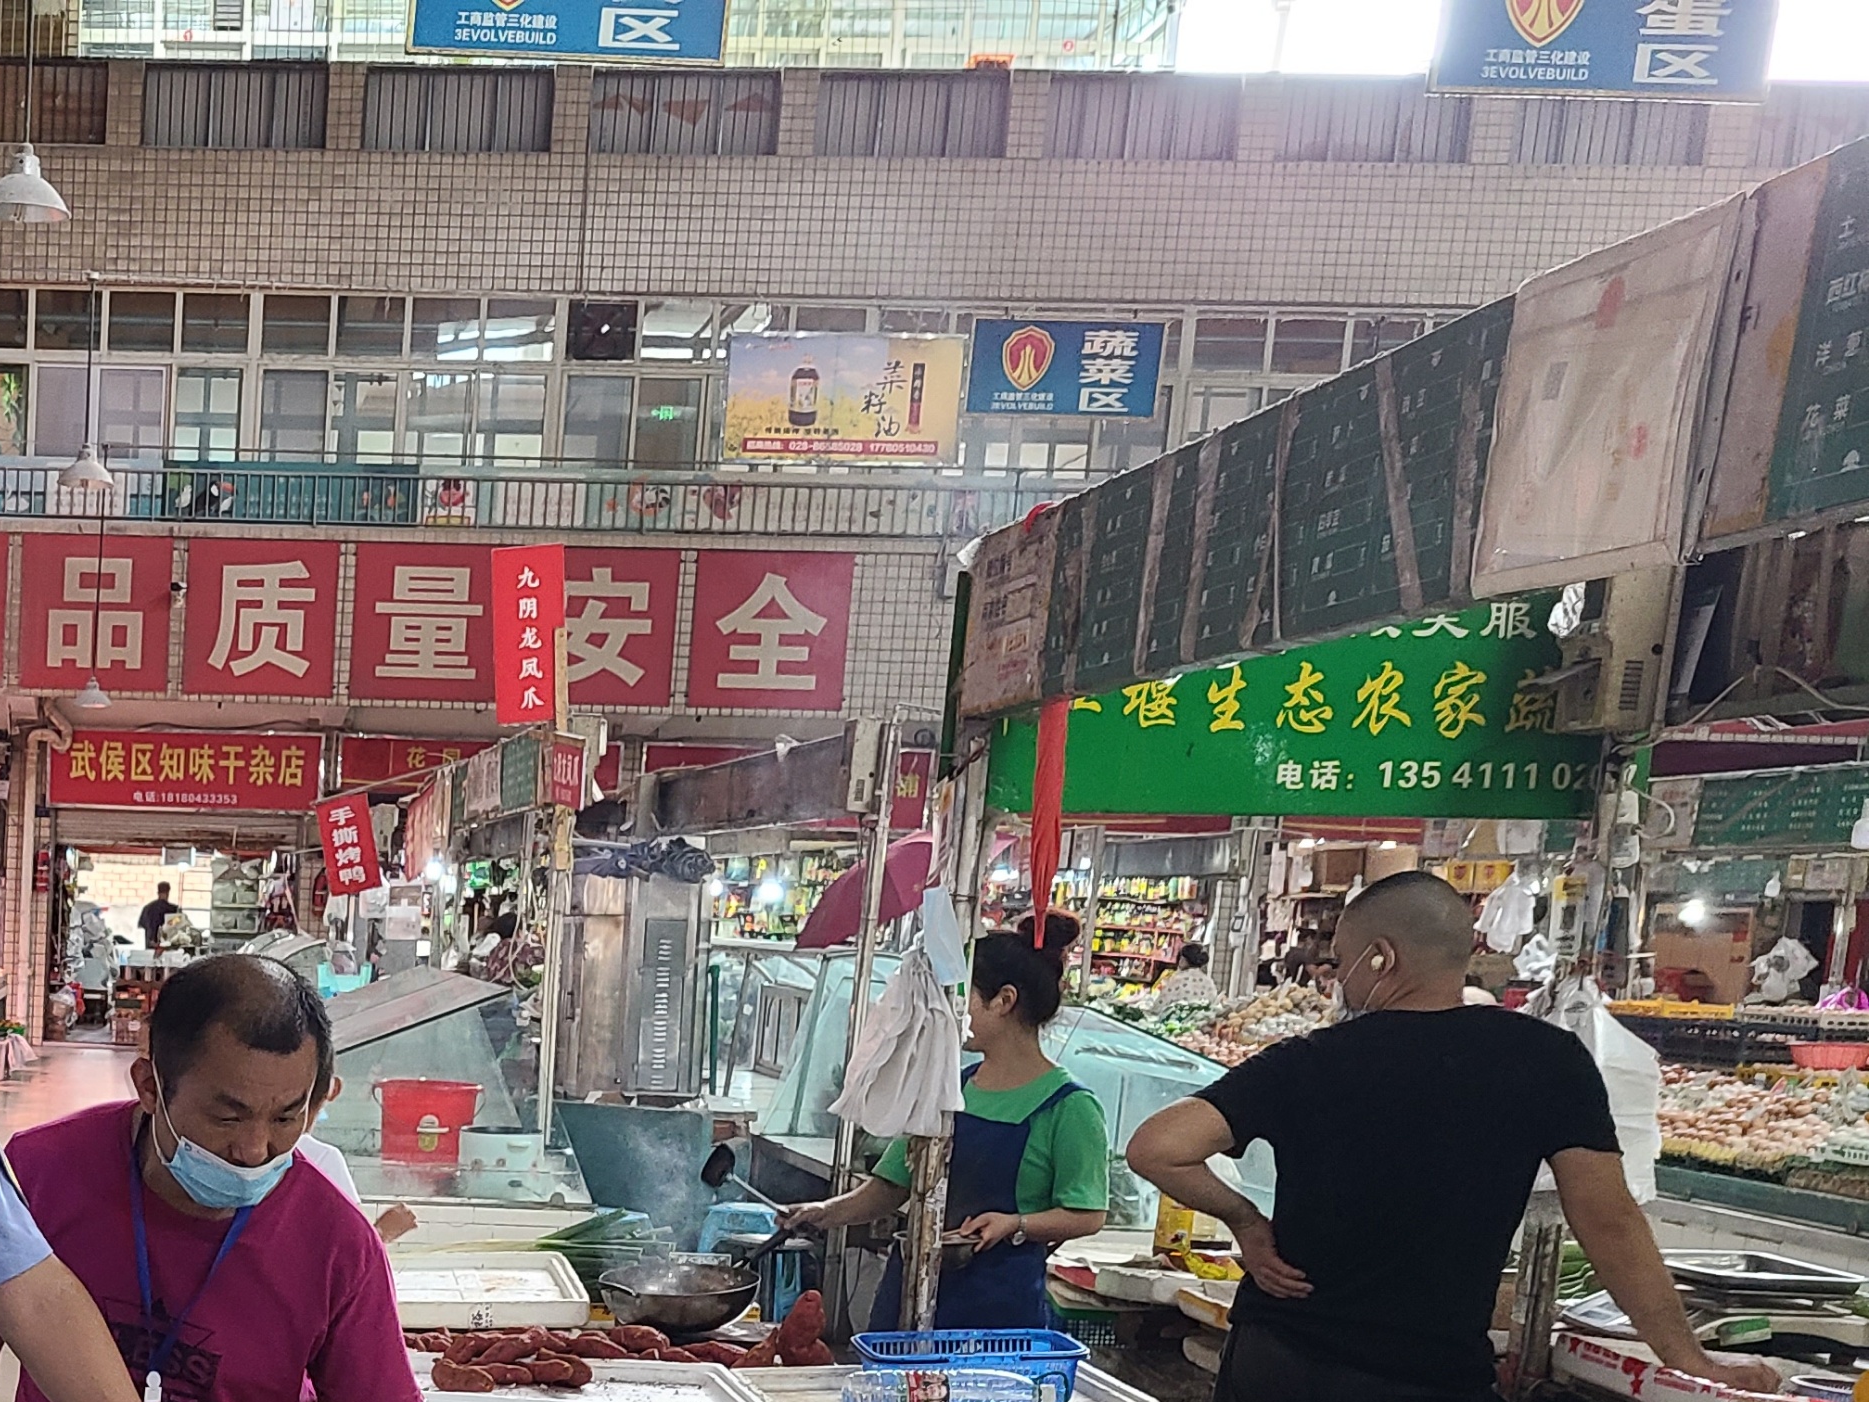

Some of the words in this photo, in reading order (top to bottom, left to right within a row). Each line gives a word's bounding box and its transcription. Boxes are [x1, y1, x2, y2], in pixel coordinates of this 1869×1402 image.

[454, 28, 556, 45] 3EVOLVEBUILD
[456, 11, 558, 30] 工商监管三化建设
[1480, 65, 1589, 82] 3EVOLVEBUILD
[1484, 49, 1591, 66] 工商监管三化建设
[1078, 330, 1140, 413] 蔬菜区
[515, 565, 545, 710] 九阴龙凤爪
[1071, 660, 1557, 740] 堰生态农家蔬
[69, 740, 306, 787] 武侯区知味干杂店
[1378, 760, 1442, 790] 135
[1451, 762, 1539, 790] 4111
[328, 805, 366, 886] 手撕烤鸭
